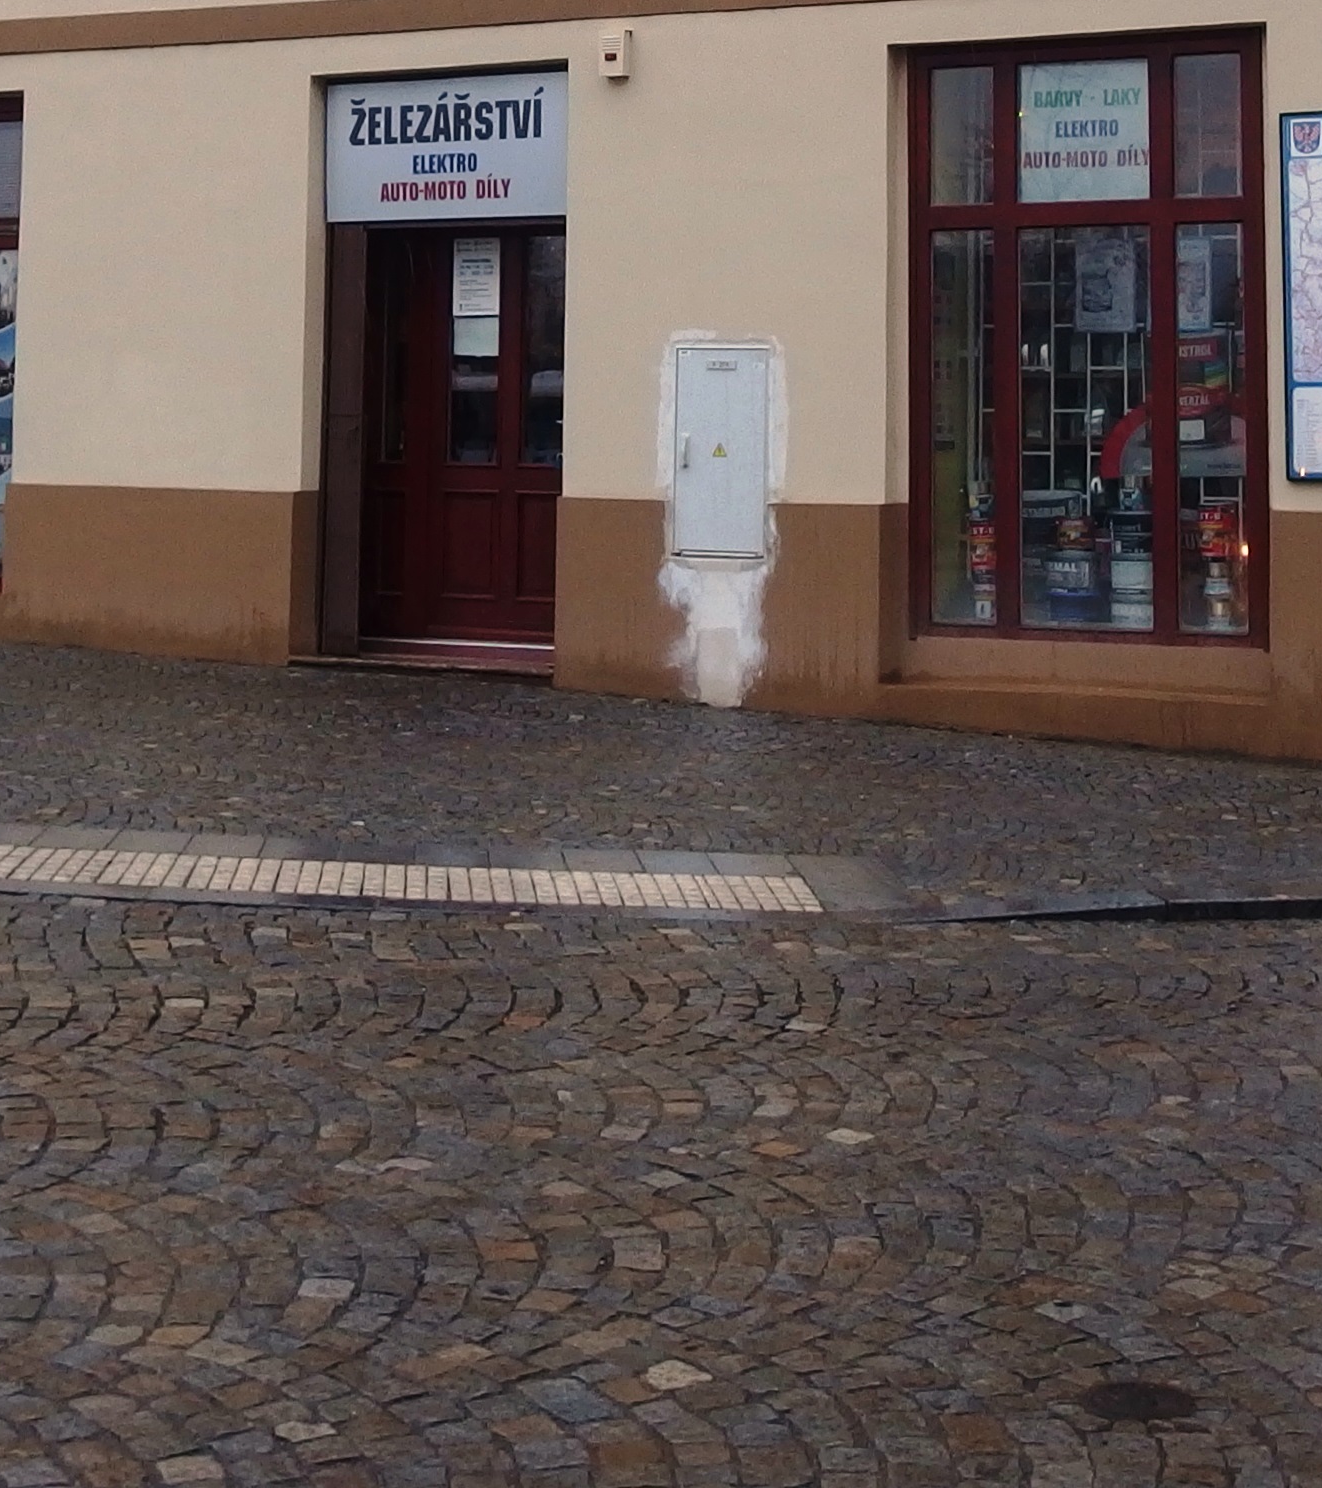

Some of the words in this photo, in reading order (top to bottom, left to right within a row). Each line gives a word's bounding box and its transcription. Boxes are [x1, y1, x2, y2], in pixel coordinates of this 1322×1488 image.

[1033, 90, 1083, 108] BARVY
[1103, 87, 1141, 106] LAKY
[349, 86, 544, 146] ŽELEZÁŘSTVÍ
[1055, 119, 1119, 138] ELEKTRO
[413, 153, 477, 175] ELEKTRO
[1023, 150, 1108, 169] AUTO-MOTO
[1117, 144, 1149, 167] DÍLY
[380, 180, 466, 202] AUTO-MOTO
[476, 173, 511, 199] DÍLY
